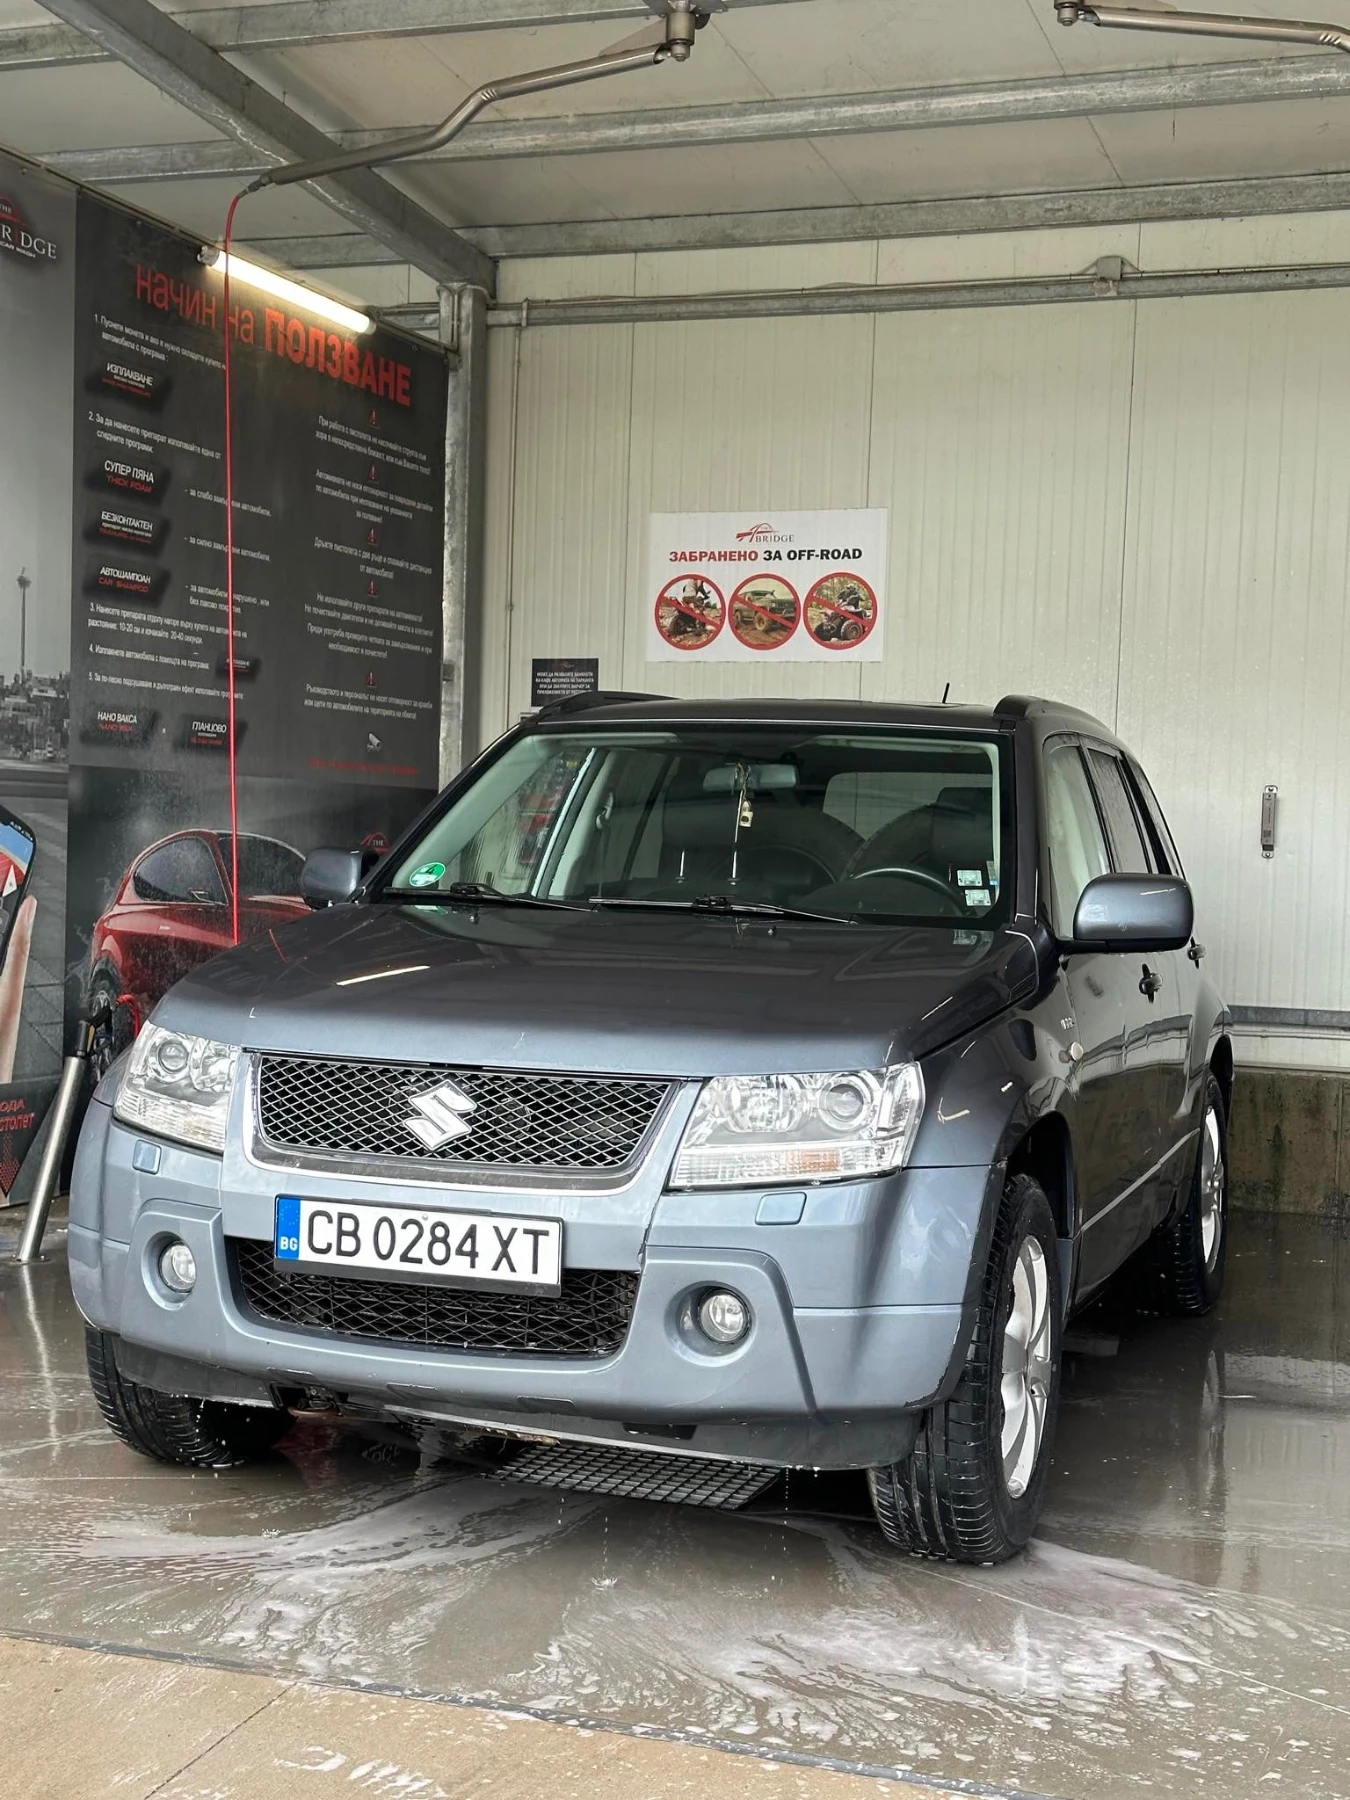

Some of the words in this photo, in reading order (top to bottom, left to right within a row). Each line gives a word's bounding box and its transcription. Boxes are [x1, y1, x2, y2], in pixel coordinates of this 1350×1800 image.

[101, 315, 123, 332] Пуснете
[125, 326, 144, 339] монета
[164, 341, 180, 352] нужно
[102, 332, 135, 349] автомобила
[140, 346, 165, 360] програма
[264, 307, 412, 407] ПОЛЗВАНЕ
[107, 362, 153, 386] ИЗПЛАКВАНЕ
[88, 411, 94, 421] 2.
[96, 413, 103, 424] За
[105, 418, 112, 427] да
[114, 421, 140, 435] нанесете
[141, 429, 167, 443] препарат
[202, 448, 214, 457] една
[97, 430, 124, 444] следните
[319, 416, 328, 429] При
[329, 421, 344, 433] работа
[350, 429, 371, 442] пистолета
[105, 459, 131, 477] СУПЕР
[132, 467, 154, 483] ПЯНА
[107, 474, 128, 487] THICK
[130, 481, 152, 493] FOAM
[190, 488, 196, 497] за
[197, 490, 213, 501] слабо
[102, 511, 153, 531] БЕЗКОНТАКТЕН
[190, 536, 196, 544] за
[197, 538, 212, 548] силно
[314, 537, 333, 550] Дръжте
[334, 544, 357, 556] пистолета
[669, 550, 759, 562] ЗАБРАНЕНО
[763, 550, 782, 561] ЗА
[787, 548, 862, 561] OFF-ROAD
[100, 566, 151, 584] АВТОШАМПОАН
[98, 577, 113, 586] CAR
[116, 580, 148, 593] SHAMPOO
[190, 584, 196, 592] за
[190, 596, 198, 605] без
[200, 600, 217, 609] лаково
[317, 592, 324, 602] Не
[90, 602, 95, 611] 3.
[96, 603, 120, 616] Нанесете
[121, 610, 146, 621] препарата
[147, 614, 162, 625] отдолу
[164, 618, 179, 628] нагоре
[180, 621, 193, 631] върху
[194, 623, 208, 632] купето
[305, 604, 311, 613] Не
[120, 622, 133, 632] 10-20
[146, 629, 169, 638] изчакайте
[171, 631, 184, 641] 20-40
[308, 623, 322, 634] Преди
[324, 628, 344, 638] употреба
[89, 643, 94, 652] 4.
[95, 644, 124, 657] Изплакнете
[126, 651, 154, 662] автомобила
[159, 656, 180, 666] помощта
[181, 659, 186, 667] на
[89, 672, 93, 680] 5.
[94, 673, 100, 682] За
[307, 684, 339, 696] Ръководството
[98, 711, 116, 722] НАНО
[117, 713, 137, 724] ВАКСА
[192, 721, 227, 733] ГЛАНЦОВО
[280, 1236, 298, 1250] BG
[307, 1209, 361, 1257] CB
[373, 1215, 479, 1270] 0284
[491, 1225, 550, 1275] XT
